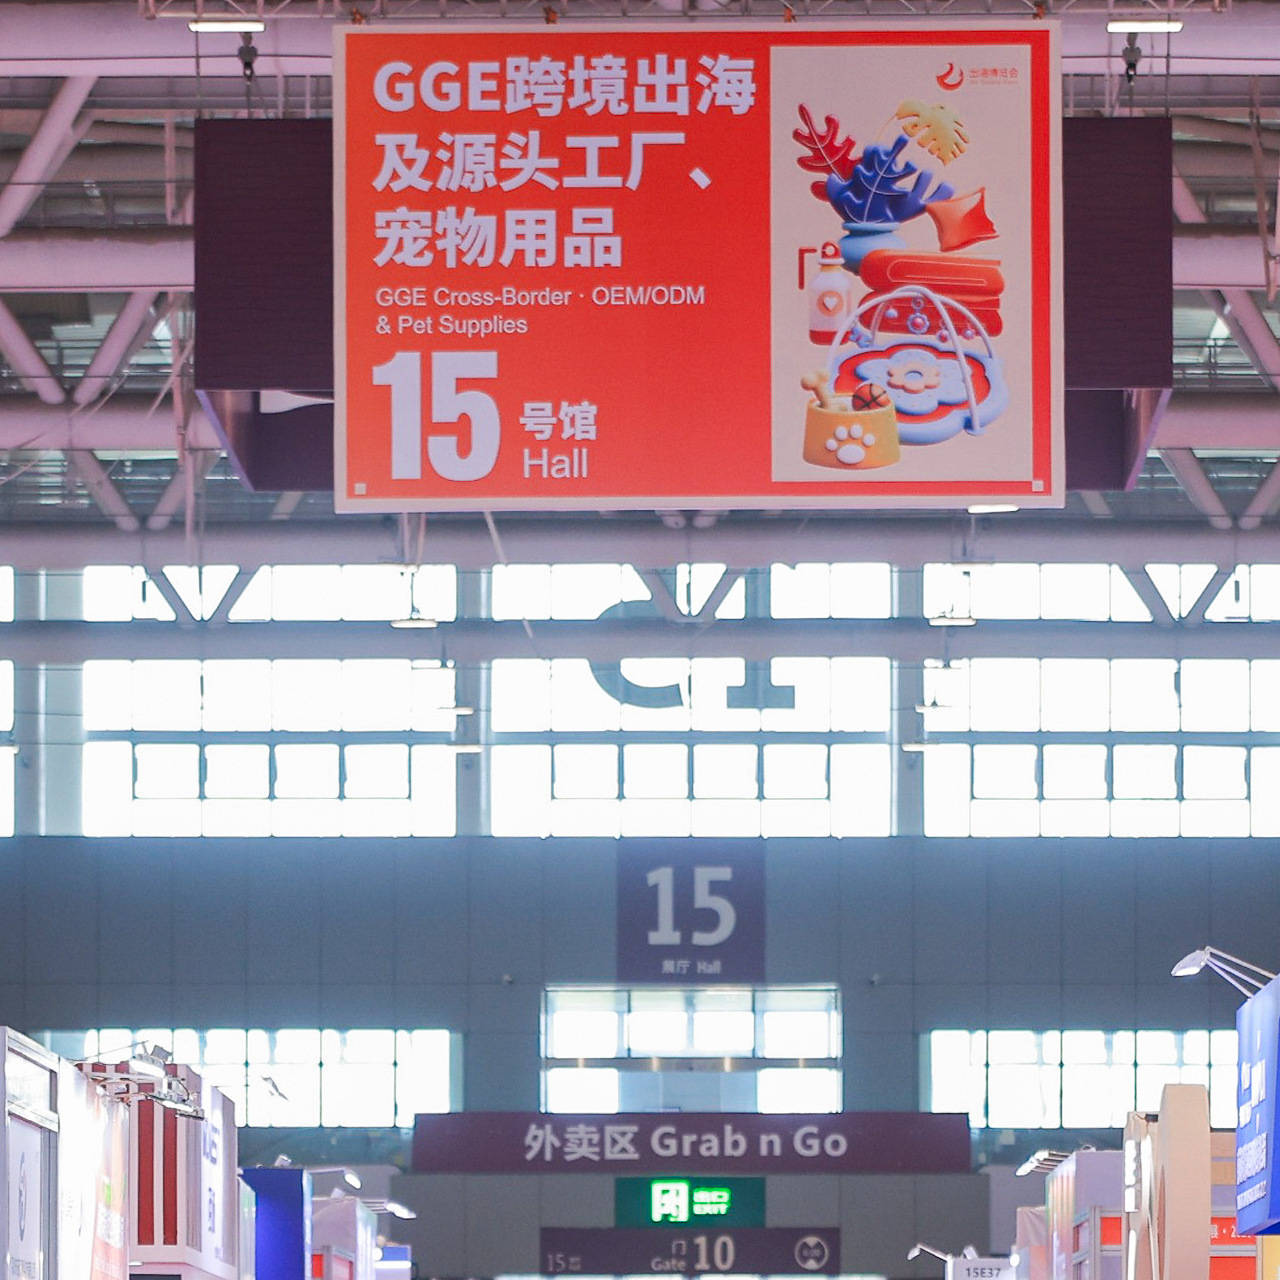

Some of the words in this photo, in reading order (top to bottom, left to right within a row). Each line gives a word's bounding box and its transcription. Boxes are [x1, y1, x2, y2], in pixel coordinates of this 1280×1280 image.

[373, 55, 756, 117] GGE跨境出海
[372, 132, 712, 193] 及源头工厂、
[373, 207, 622, 269] 宠物用品
[375, 287, 427, 306] GGE
[434, 287, 572, 306] Cross-Border
[592, 287, 706, 306] OEM/ODM
[375, 316, 393, 335] &
[399, 316, 433, 335] Pet
[439, 315, 528, 338] Supplies
[372, 351, 501, 482] 15
[520, 402, 597, 442] 号馆
[524, 449, 589, 480] Hall
[646, 866, 737, 947] 15
[697, 960, 722, 975] Hall
[525, 1125, 638, 1162] 外卖区
[651, 1126, 746, 1157] Grab
[760, 1132, 781, 1157] n
[793, 1127, 848, 1157] Go
[548, 1254, 565, 1271] 15
[651, 1257, 687, 1271] Gate
[693, 1235, 735, 1271] 10
[966, 1267, 1001, 1278] 15E37
